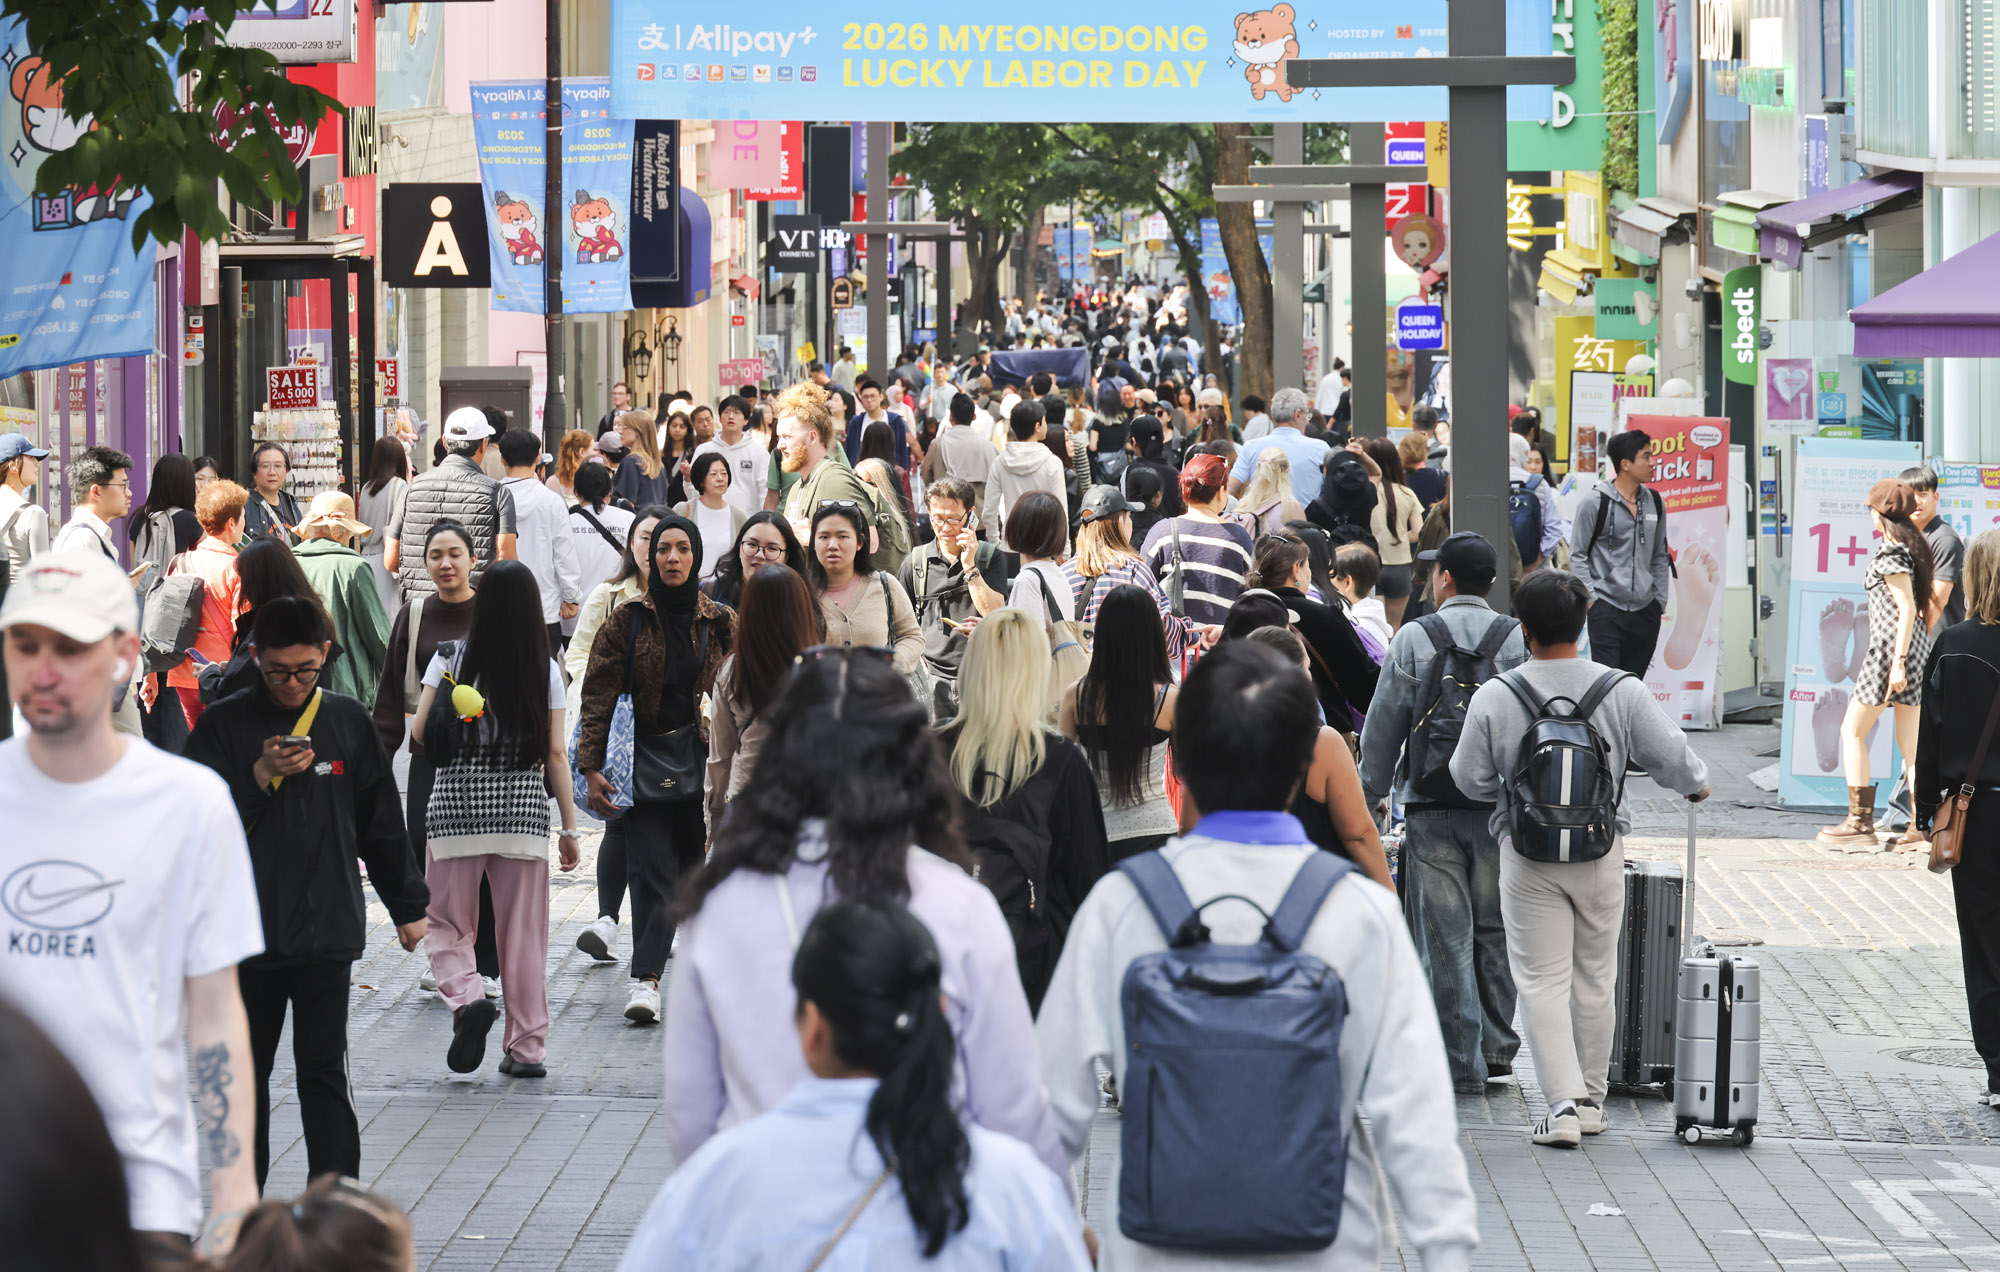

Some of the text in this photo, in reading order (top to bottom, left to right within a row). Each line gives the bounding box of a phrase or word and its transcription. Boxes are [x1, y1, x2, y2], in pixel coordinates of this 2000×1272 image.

[686, 24, 818, 58] Alipay+
[842, 22, 1208, 52] 2026 MYEONGDONG
[1328, 28, 1369, 39] HOSTED
[1371, 29, 1385, 39] BY
[843, 58, 1208, 88] LUCKY LABOR DAY
[654, 132, 670, 188] Rockfish
[1390, 150, 1424, 161] QUEEN
[643, 138, 656, 222] Weatherwear
[778, 230, 815, 250] VT
[1401, 315, 1436, 327] QUEEN
[1731, 287, 1754, 364] sbedt
[1399, 328, 1442, 340] HOLIDAY
[270, 371, 315, 388] SALE
[1794, 665, 1813, 673] Before
[1792, 690, 1814, 701] After
[9, 930, 97, 959] KOREA
